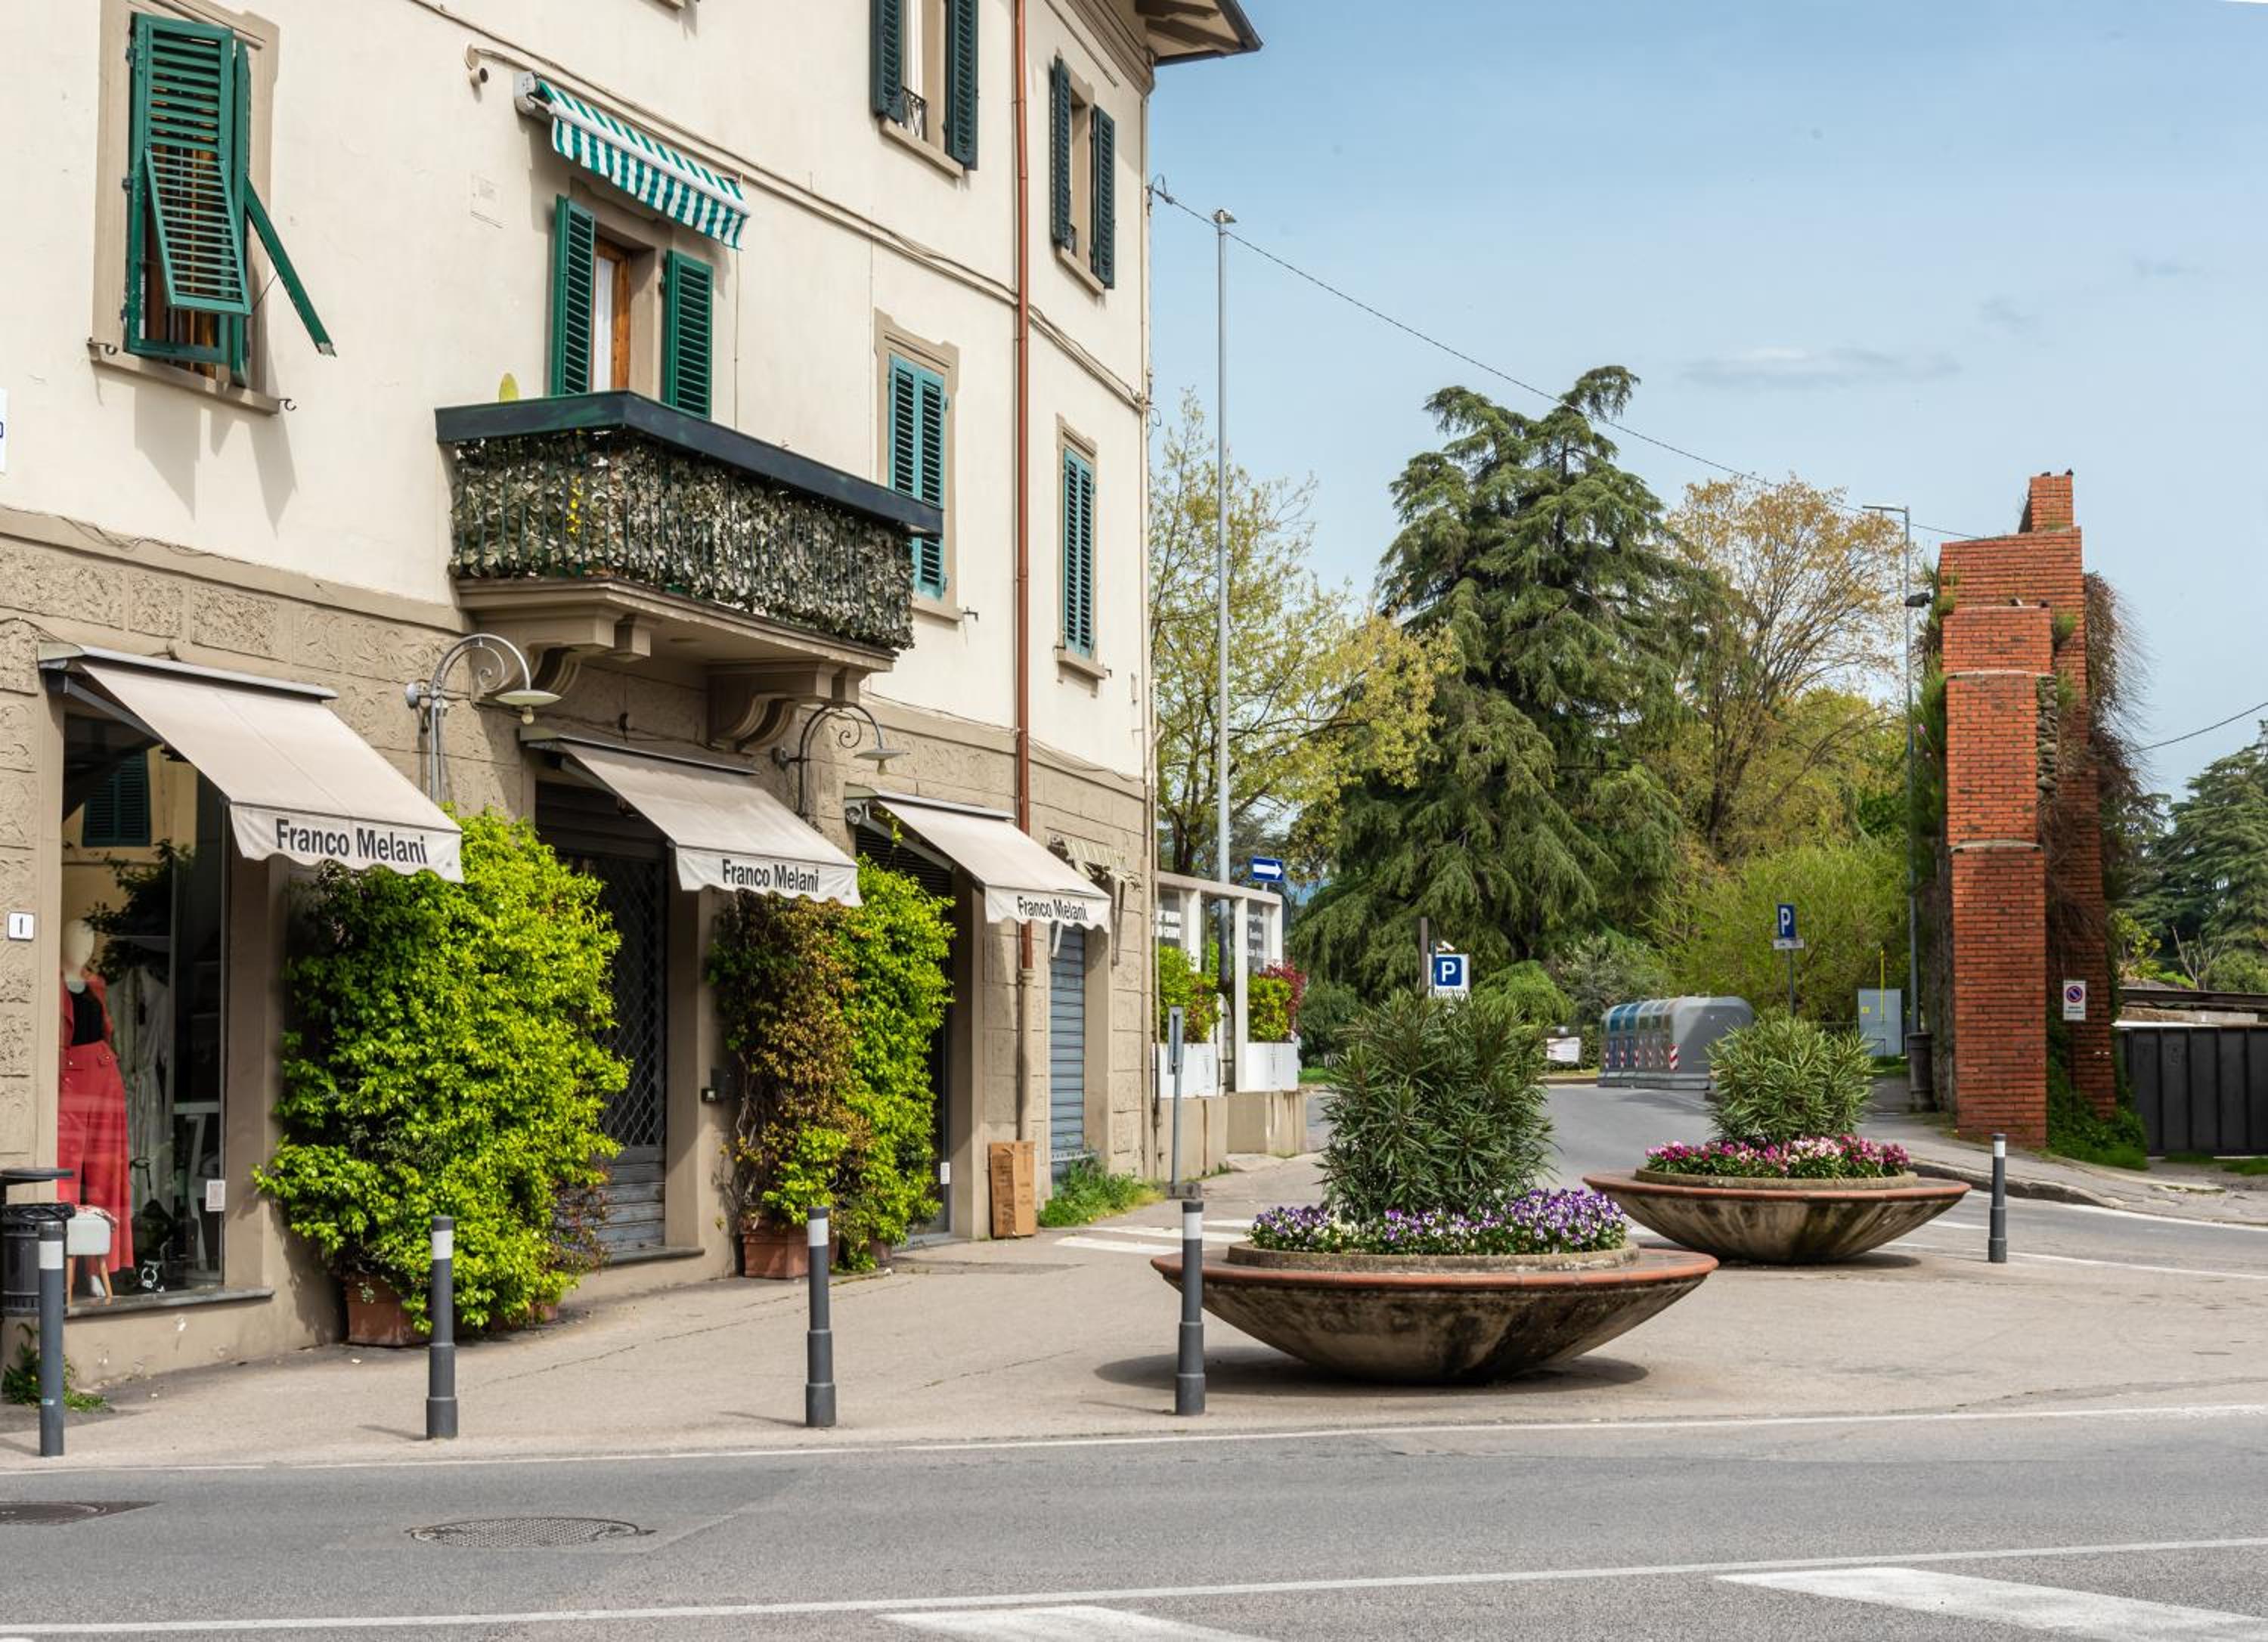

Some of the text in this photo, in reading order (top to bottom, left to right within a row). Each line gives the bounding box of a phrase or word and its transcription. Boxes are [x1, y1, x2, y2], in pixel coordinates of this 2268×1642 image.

[276, 818, 428, 864] Franco Melani
[722, 859, 819, 893] Franco Melani
[1018, 895, 1088, 920] Franco Melani
[1780, 908, 1791, 935] P
[1442, 961, 1456, 982] P
